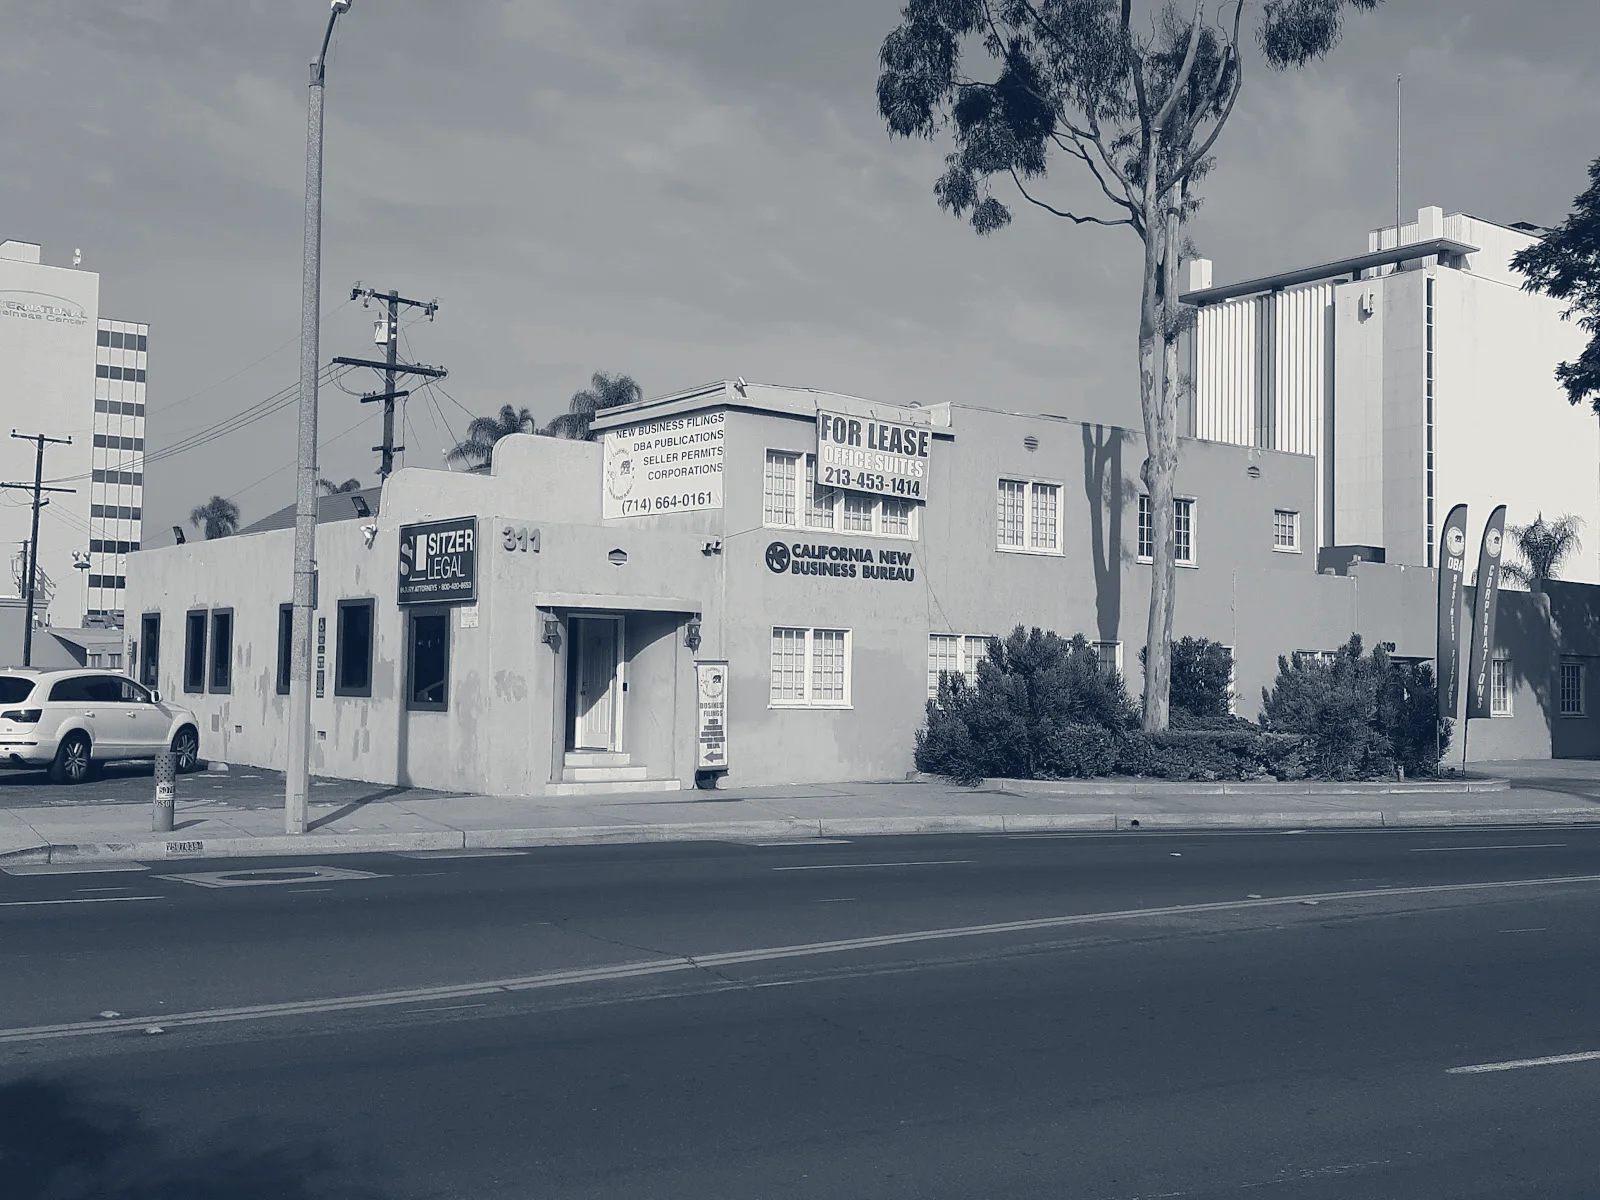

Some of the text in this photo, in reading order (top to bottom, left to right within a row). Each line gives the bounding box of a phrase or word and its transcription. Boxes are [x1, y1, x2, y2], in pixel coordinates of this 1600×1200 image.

[616, 413, 725, 439] NEW BUSINESS FILINGS
[821, 414, 929, 458] FOR LEASE
[633, 430, 724, 452] DBA PUBLICATIONS
[643, 452, 678, 466] SELLER
[681, 446, 724, 461] PERMITS
[823, 445, 924, 478] OFFICE SUITES
[648, 463, 723, 481] CORPORATIONS
[825, 466, 920, 497] 213-453-1414
[621, 497, 652, 516] (714)
[655, 491, 712, 510] 664-0161
[428, 529, 473, 555] SITZER
[503, 526, 541, 553] 311
[427, 555, 466, 579] LEGAL
[791, 543, 912, 566] CALIFORNIA NEW
[1448, 556, 1463, 573] DBA
[791, 560, 915, 582] BUSINESS BUREAU
[1477, 564, 1495, 709] CORPORATIONS
